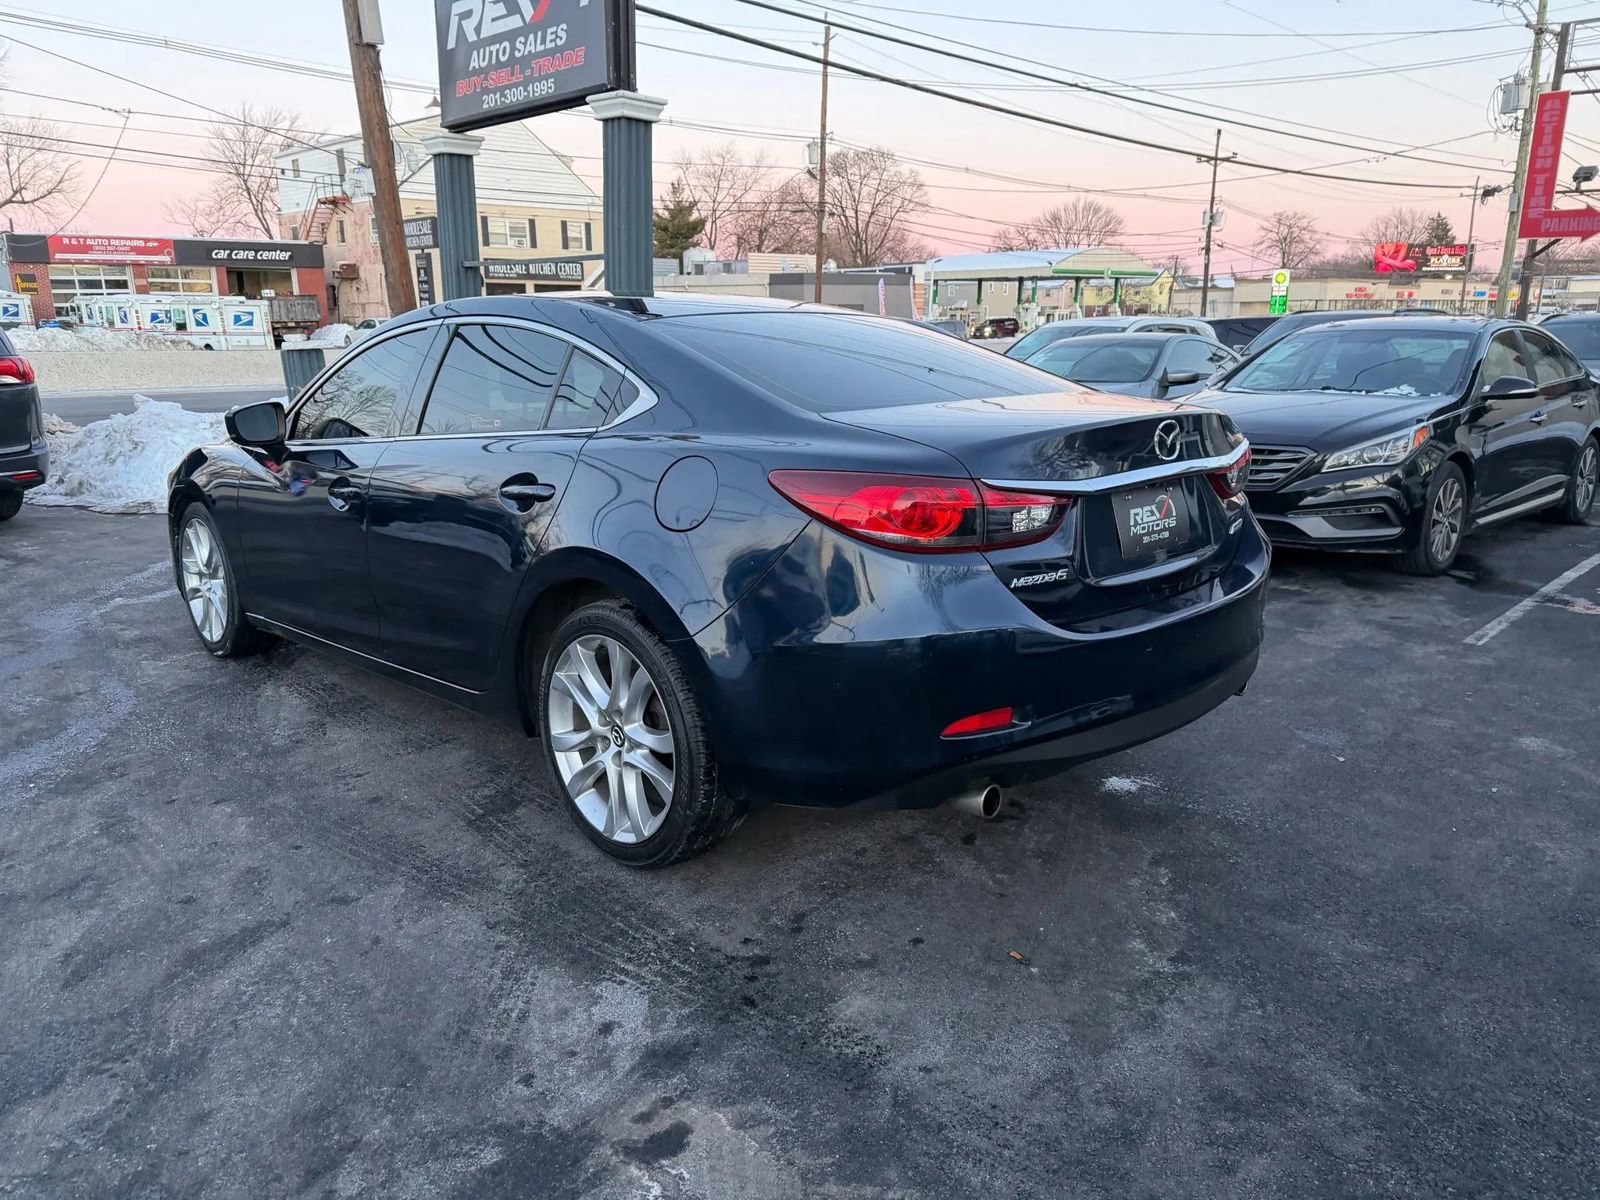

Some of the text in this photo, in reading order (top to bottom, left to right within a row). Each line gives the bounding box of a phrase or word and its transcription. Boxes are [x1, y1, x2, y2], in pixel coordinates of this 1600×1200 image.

[469, 23, 567, 71] AUTO SALES
[482, 78, 555, 109] 201-300-1995
[1535, 99, 1561, 169] ACTION
[1528, 173, 1550, 218] TIRE
[1541, 215, 1600, 232] PARKING
[86, 238, 109, 246] AUTO
[110, 239, 145, 247] REPAIRS
[211, 249, 292, 260] car care center
[488, 262, 582, 276] WHOLESALE KITCHEN CENTER
[1130, 504, 1166, 526] REV
[1130, 517, 1177, 536] MOTORS
